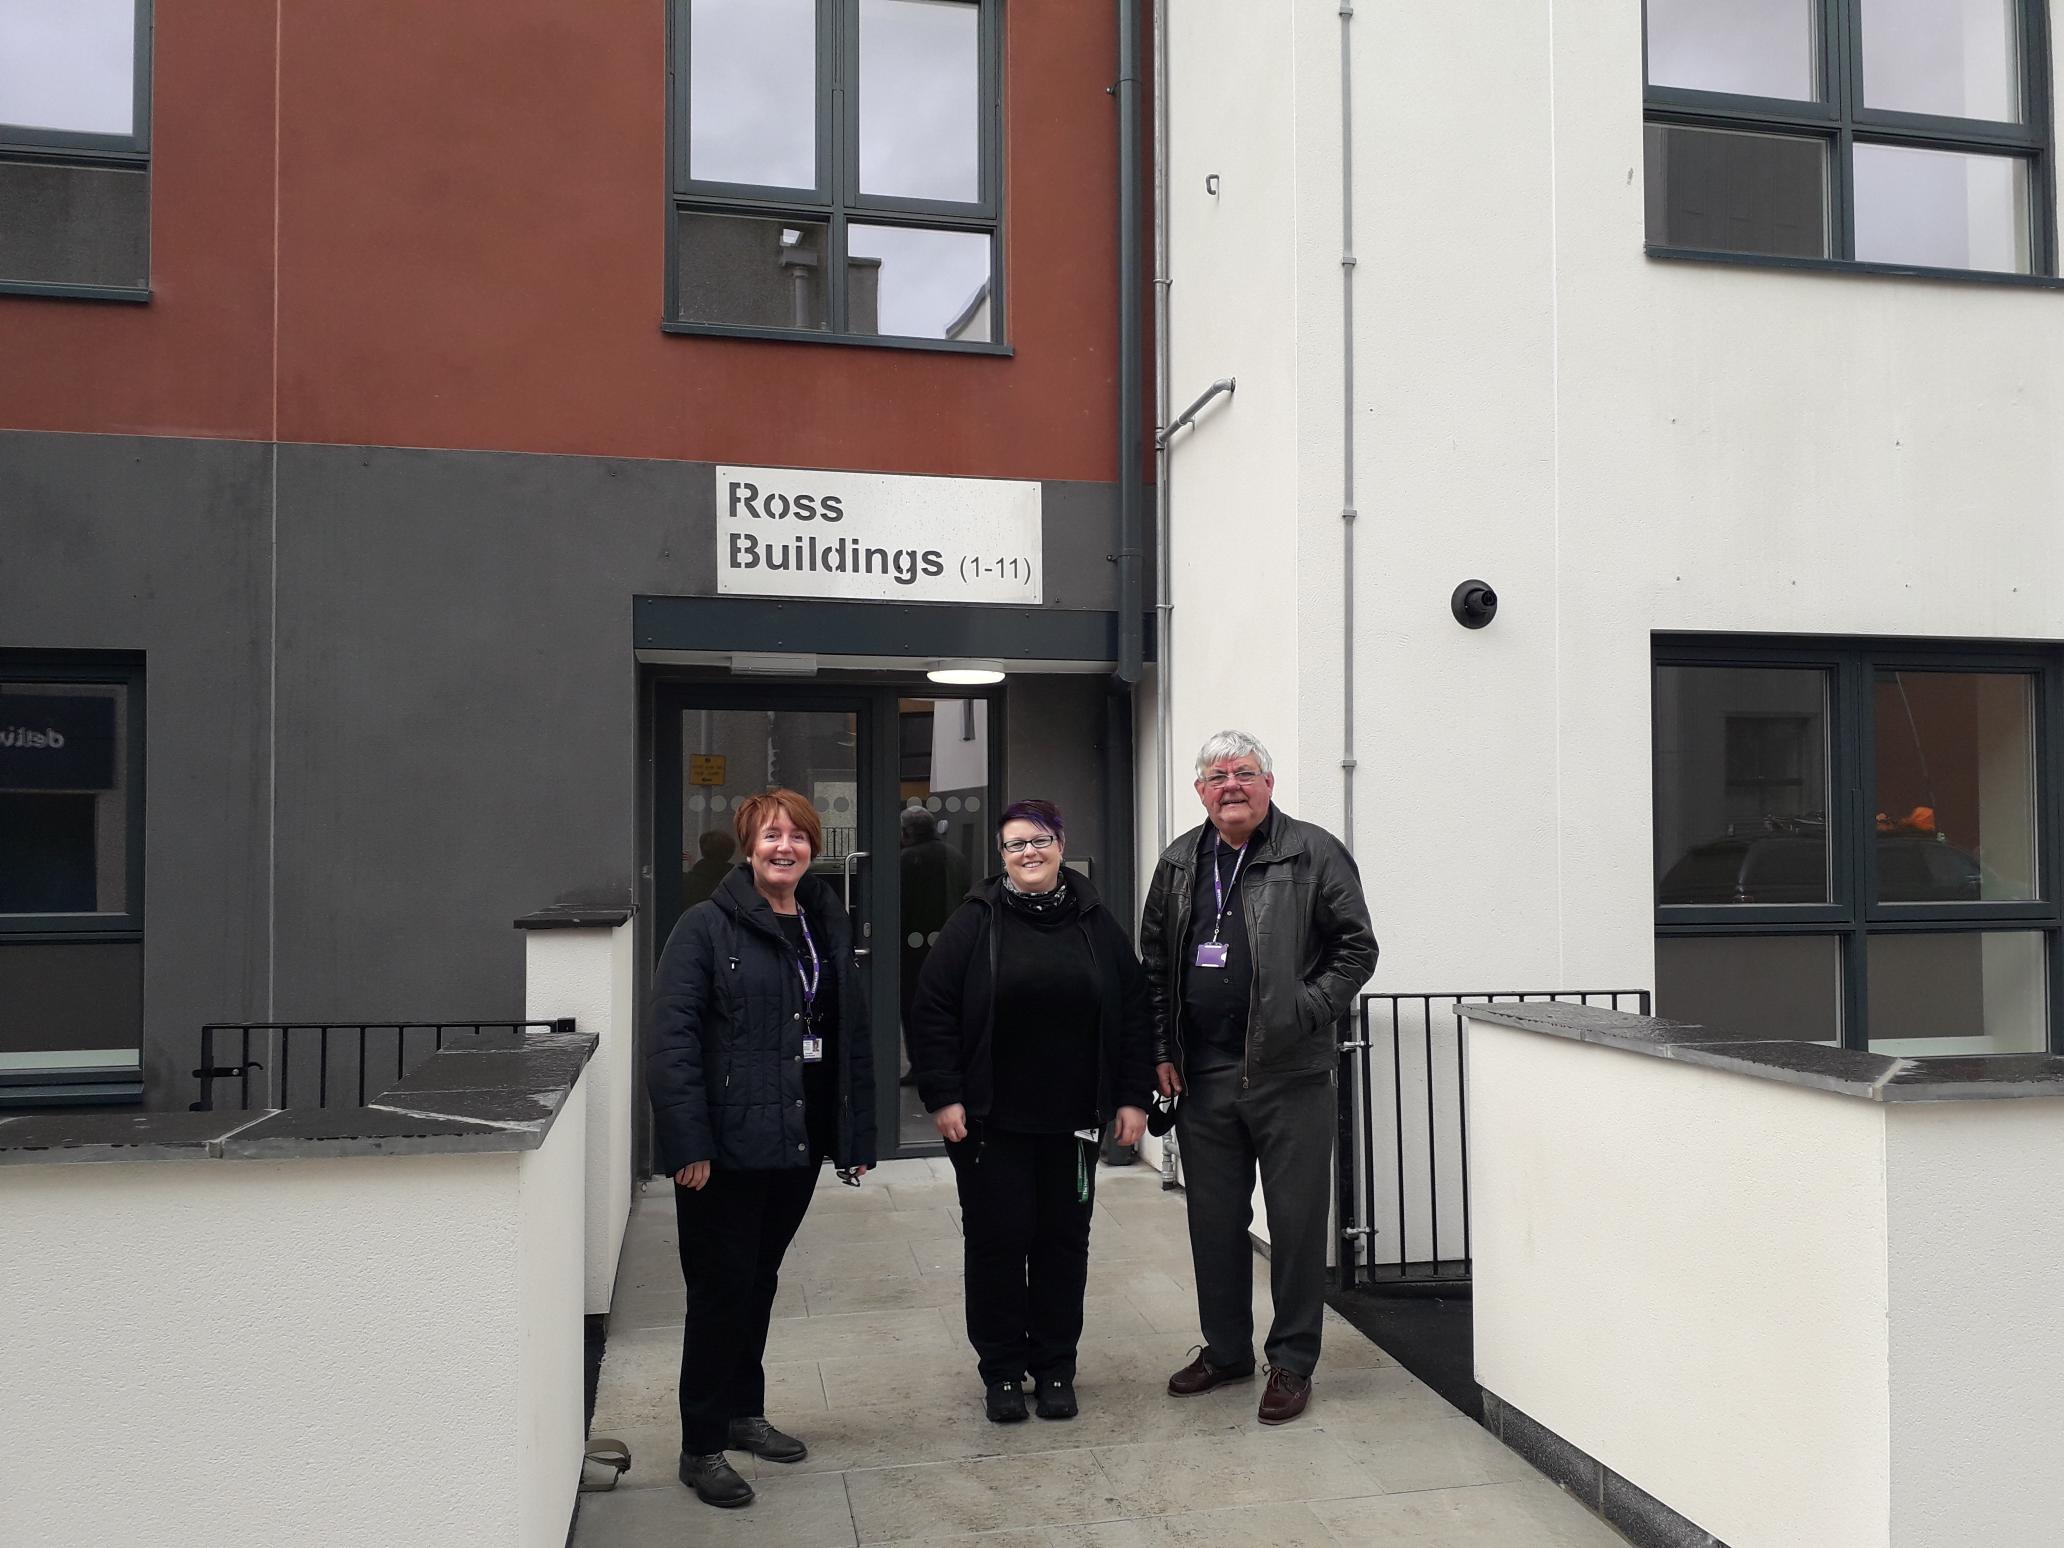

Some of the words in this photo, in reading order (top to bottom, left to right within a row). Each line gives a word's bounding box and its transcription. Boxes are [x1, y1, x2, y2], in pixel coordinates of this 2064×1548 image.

[728, 481, 844, 523] Ross
[729, 532, 944, 585] Buildings
[959, 555, 1032, 585] (1-11)
